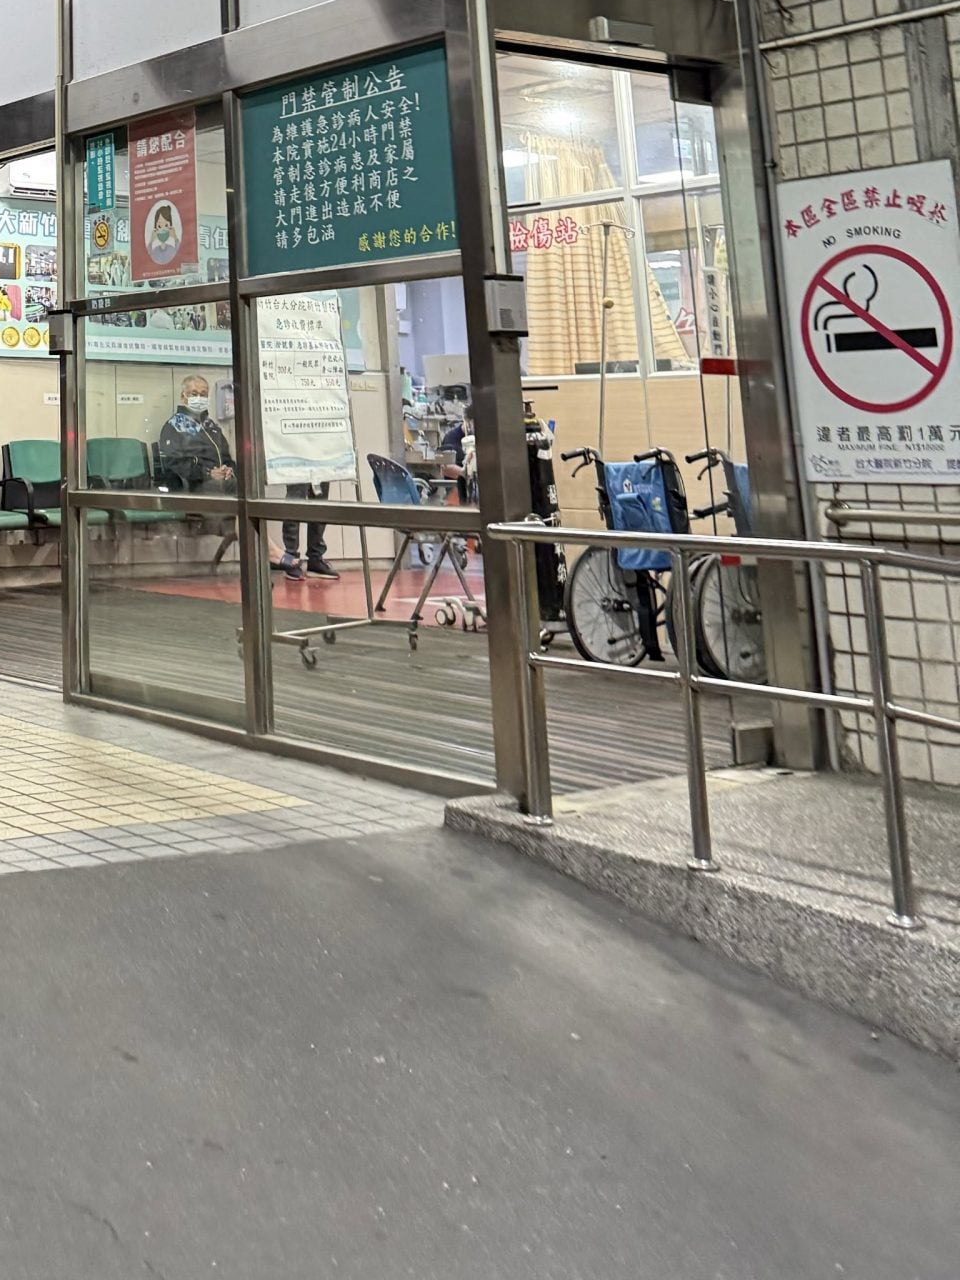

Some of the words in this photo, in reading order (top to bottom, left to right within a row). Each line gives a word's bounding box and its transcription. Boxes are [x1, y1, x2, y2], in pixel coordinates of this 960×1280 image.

[281, 65, 406, 115] 門禁管制公告
[272, 93, 420, 143] 為維護急診病人安全!
[136, 130, 186, 158] 請您配合
[272, 118, 413, 164] 本院實施24小時門禁
[273, 140, 415, 186] 管制急診病患及家屬
[273, 166, 419, 207] 請走後方便利商店之
[275, 190, 402, 228] 大門進出造成不便
[275, 224, 335, 249] 請多包涵
[358, 221, 456, 251] 感謝您的合作!
[822, 235, 837, 249] NO
[846, 225, 902, 239] SMOKING
